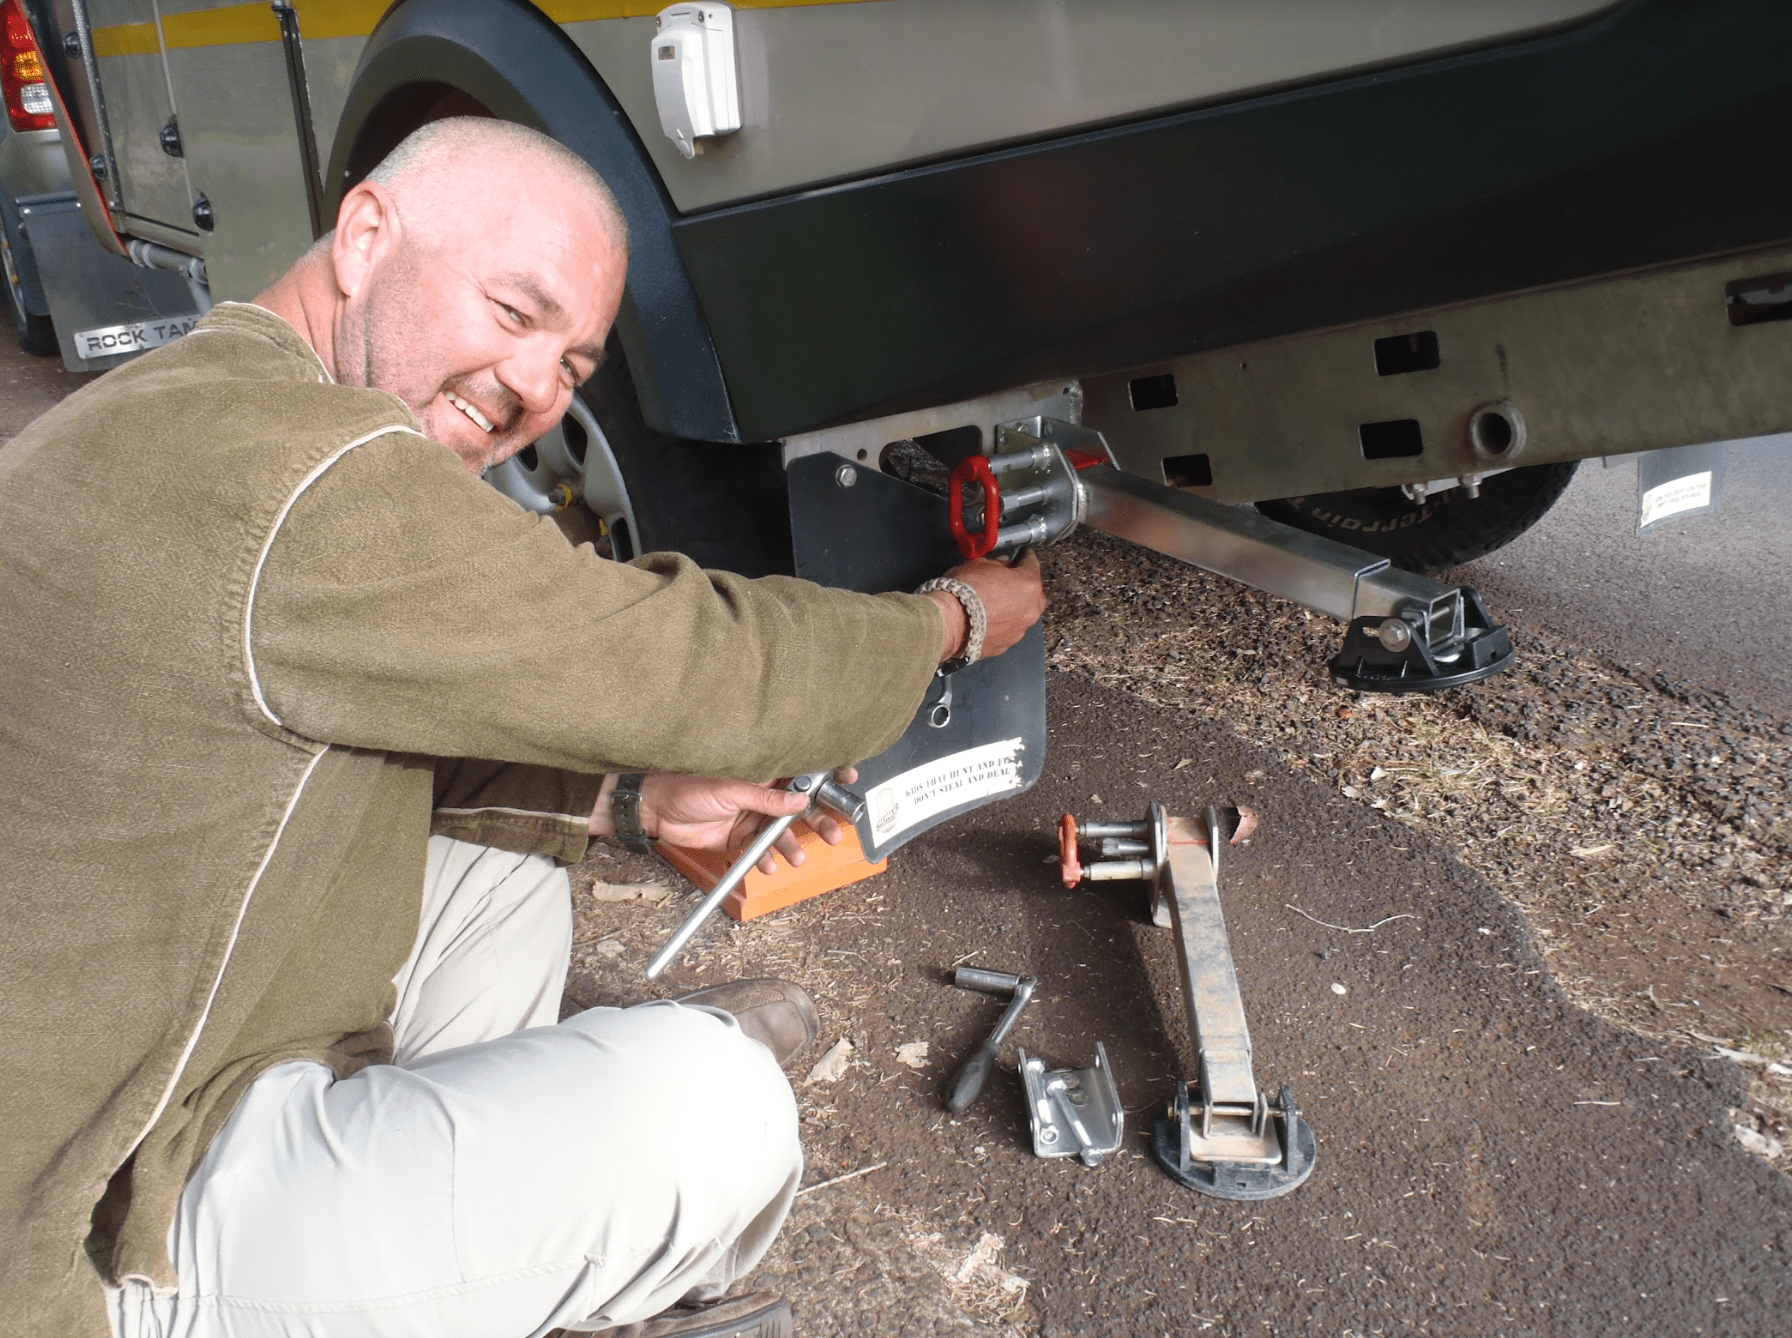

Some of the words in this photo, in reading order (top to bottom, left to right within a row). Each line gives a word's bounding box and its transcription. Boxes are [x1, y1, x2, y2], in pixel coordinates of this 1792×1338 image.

[87, 330, 147, 351] ROCK
[905, 784, 924, 798] KIDS
[926, 774, 947, 788] THAT
[949, 765, 974, 778] HUNT
[978, 760, 995, 770] AND
[939, 779, 963, 793] STEAL
[968, 773, 984, 784] AND
